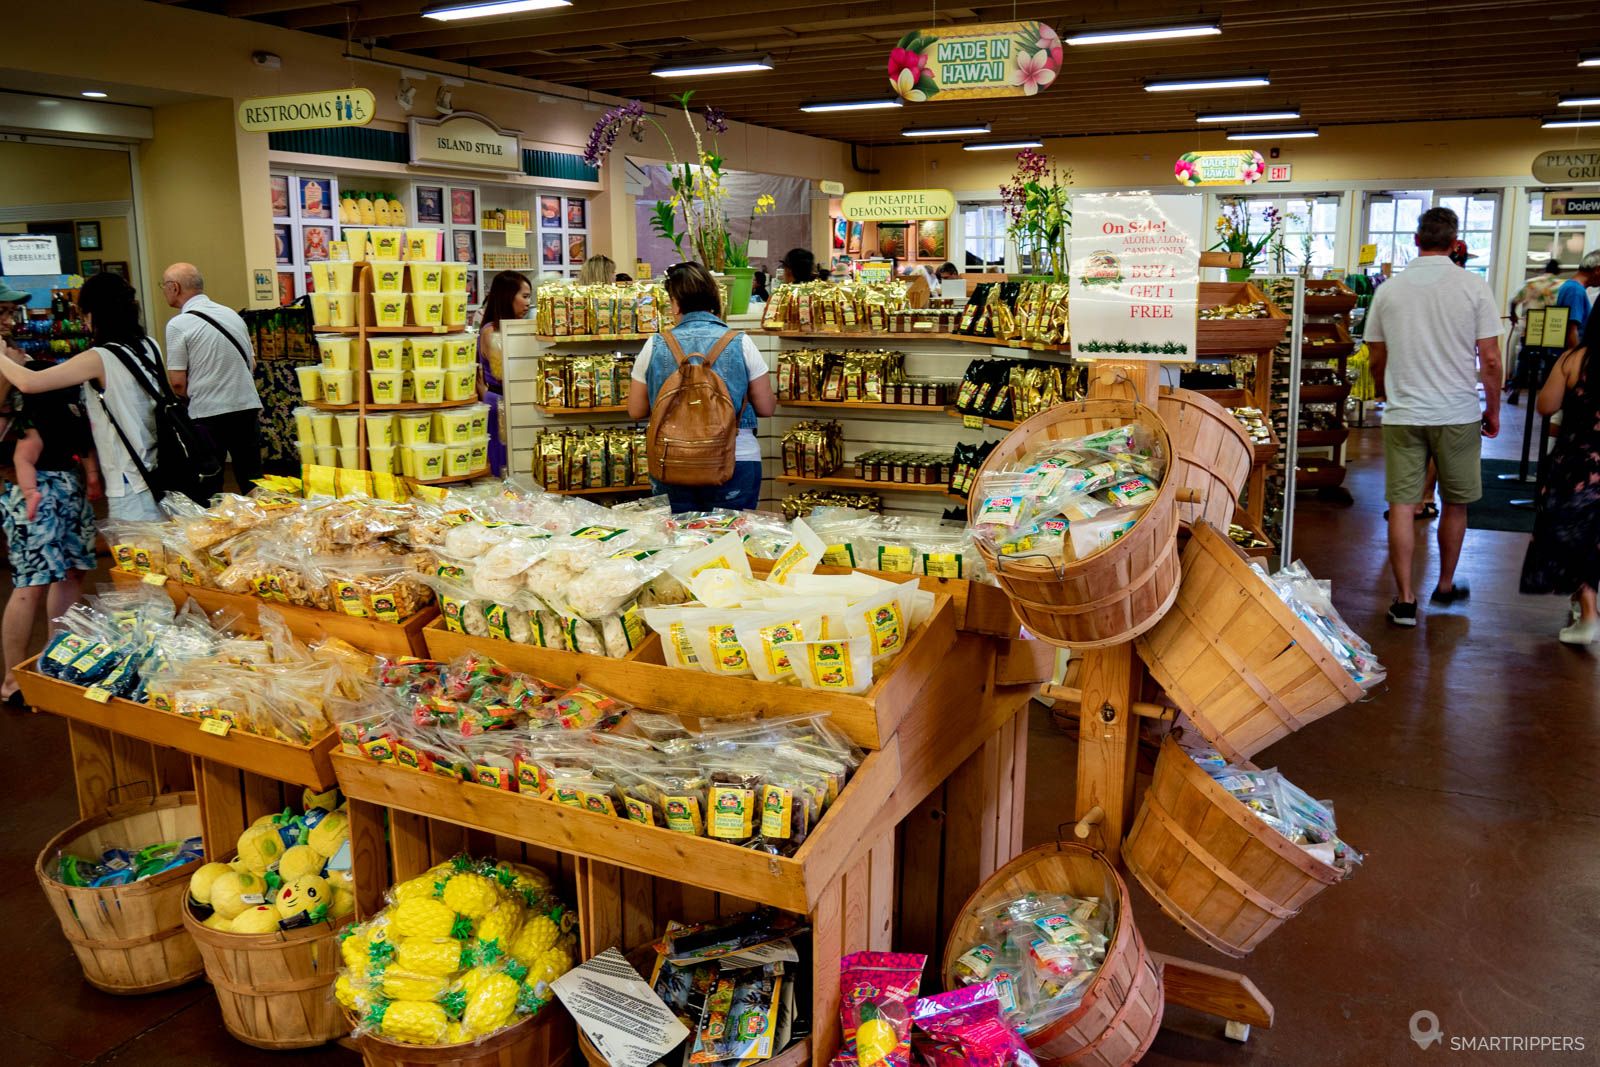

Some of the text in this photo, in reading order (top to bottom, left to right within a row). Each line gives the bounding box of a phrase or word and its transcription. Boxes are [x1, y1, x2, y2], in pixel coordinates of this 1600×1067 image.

[937, 39, 1011, 63] MADE IN
[942, 61, 1005, 84] HAWAII
[246, 101, 332, 123] RESTROOMS
[437, 137, 503, 156] ISLAND STYLE
[1201, 158, 1239, 168] MADE IN
[1203, 167, 1237, 179] HAWAII
[1271, 167, 1288, 180] EXIT
[1567, 166, 1600, 179] GRI
[868, 194, 926, 206] PINEAPPLE
[850, 205, 947, 217] DEMONSTRATION
[1102, 222, 1125, 234] On
[1131, 264, 1166, 279] BUY
[1129, 284, 1175, 298] GET 1
[1130, 304, 1174, 318] FREE
